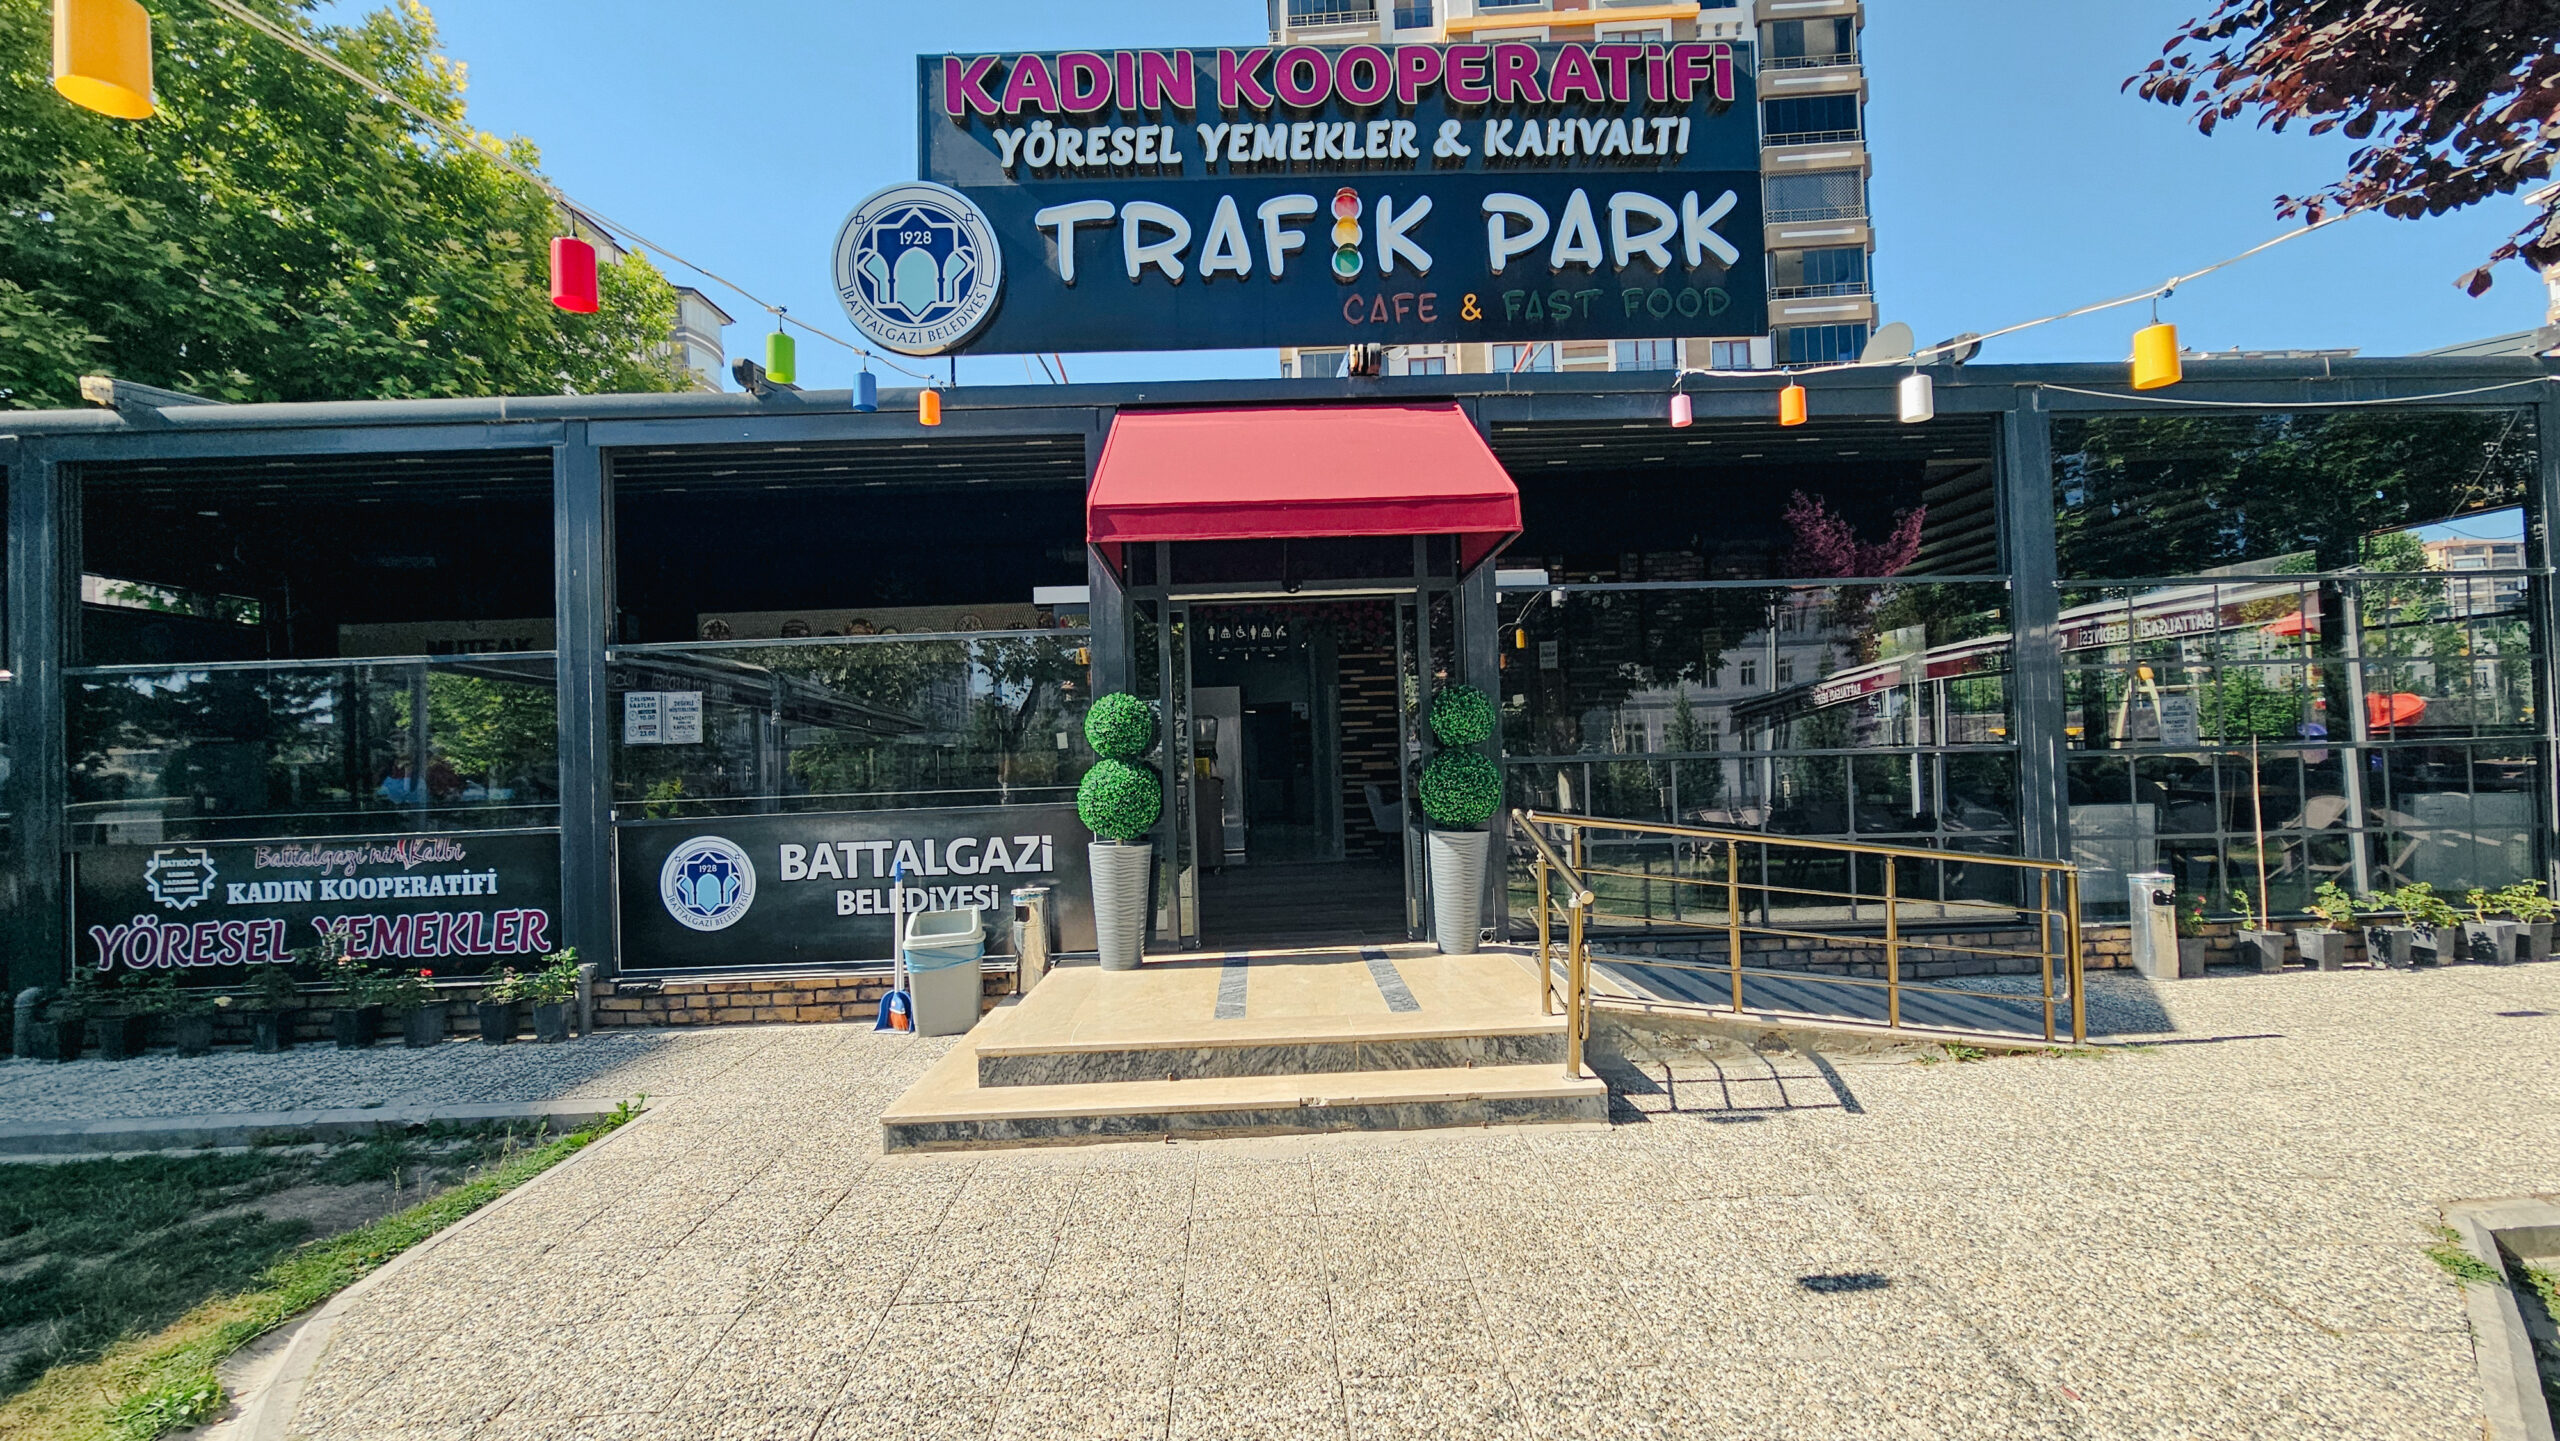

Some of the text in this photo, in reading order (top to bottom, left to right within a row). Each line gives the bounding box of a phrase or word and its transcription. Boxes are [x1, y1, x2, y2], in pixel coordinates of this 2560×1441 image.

[943, 41, 1735, 116] KADIN KOOPERATİFİ
[992, 115, 1691, 169] YÖRESEL YEMEKLER & KAHVALTI
[899, 231, 932, 245] 1928
[1482, 187, 1740, 275] PARK
[1343, 286, 1732, 325] CAFE & FAST FOOD
[404, 836, 467, 871] Kalbi
[699, 865, 718, 873] 1928
[779, 834, 1054, 882] BATTALGAZİ
[227, 867, 499, 904] KADIN KOOPERATİFİ
[836, 884, 998, 916] BELEDİYESİ
[89, 908, 551, 971] YÖRESEL YEMEKLER
